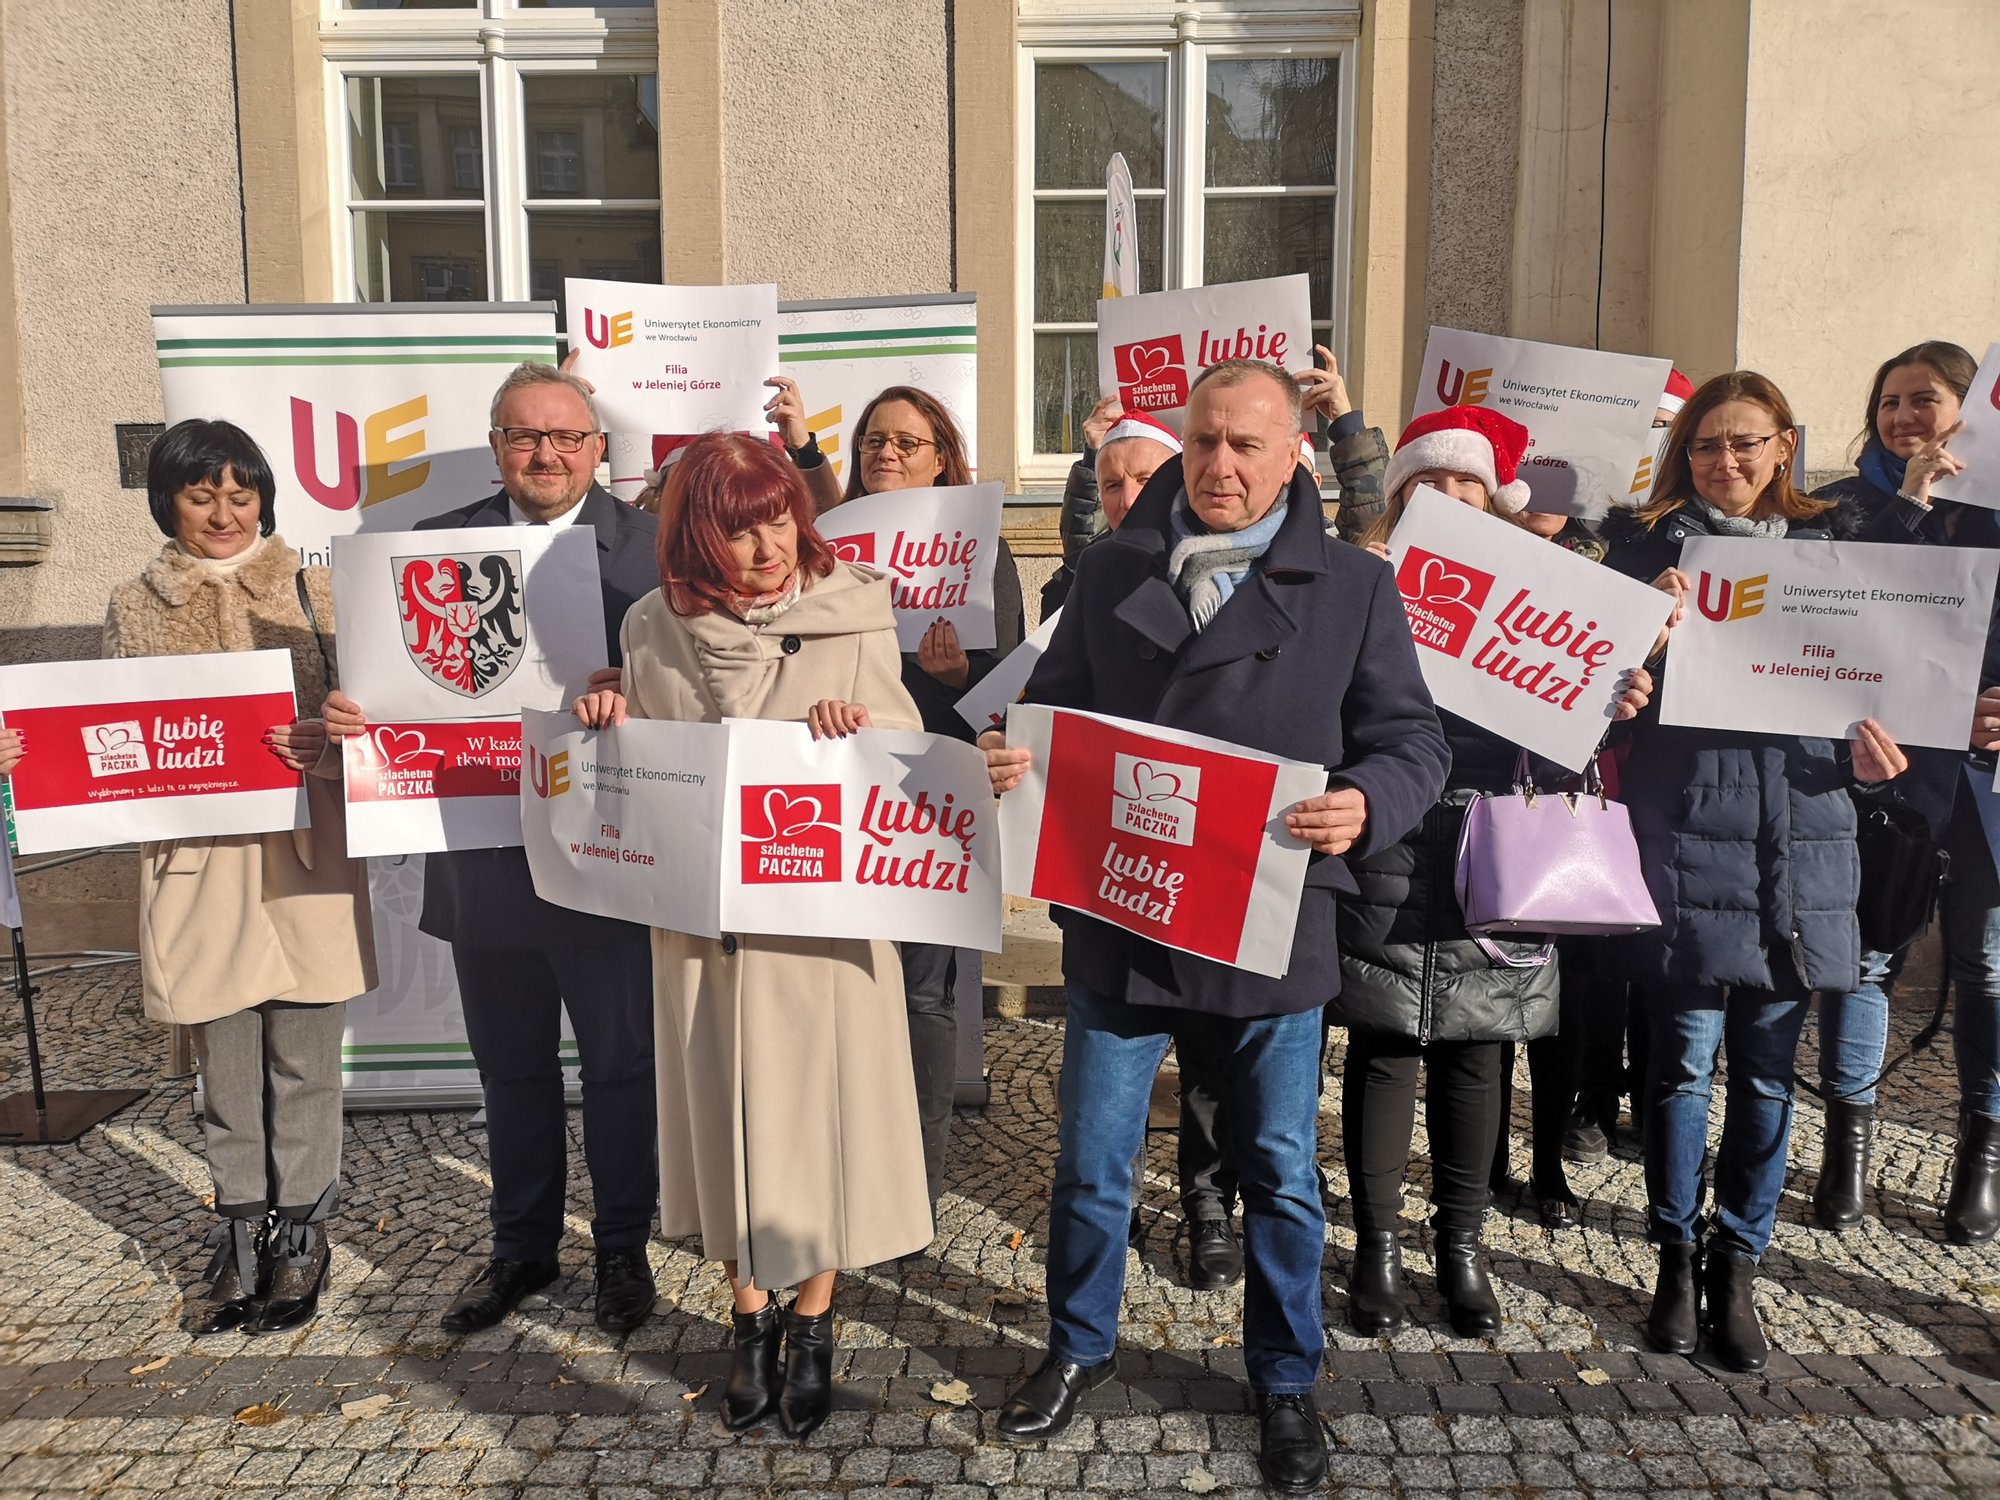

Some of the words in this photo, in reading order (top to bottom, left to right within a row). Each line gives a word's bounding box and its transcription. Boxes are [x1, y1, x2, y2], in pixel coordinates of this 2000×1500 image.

[584, 307, 634, 350] UE
[644, 318, 700, 330] Uniwersytet
[703, 318, 762, 329] Ekonomiczny
[658, 333, 698, 342] Wrocławiu
[1197, 324, 1289, 369] Lubię
[665, 364, 688, 375] Filia
[632, 381, 642, 389] w
[645, 380, 687, 392] Jeleniej
[690, 380, 721, 390] Górze
[1132, 382, 1176, 395] szlachetna
[1436, 358, 1493, 407] UE
[1502, 378, 1568, 399] Uniwersytet
[1569, 389, 1641, 409] Ekonomiczny
[1133, 392, 1179, 408] PACZKA
[1499, 396, 1513, 406] we
[1513, 397, 1559, 413] Wrocławiu
[290, 394, 431, 512] UE
[1532, 454, 1569, 469] Górze
[887, 530, 978, 579] Lubię
[891, 573, 971, 610] ludzi
[1697, 570, 1769, 623] UE
[1783, 584, 1867, 601] Uniwersytet
[1870, 589, 1966, 608] Ekonomiczny
[1403, 601, 1456, 633] szlachetna
[1781, 605, 1798, 614] we
[1800, 604, 1859, 617] Wrocławiu
[1494, 588, 1615, 676] Lubię
[1802, 644, 1836, 659] Filia
[1471, 635, 1590, 712] ludzi
[1751, 663, 1766, 674] w
[1769, 662, 1830, 681] Jeleniej
[1835, 667, 1883, 683] Górze
[152, 713, 225, 749] Lubię
[466, 737, 484, 751] W
[100, 753, 137, 761] szlachetna
[101, 760, 139, 772] PACZKA
[156, 743, 225, 770] ludzi
[456, 752, 491, 767] tkwi
[377, 768, 433, 781] szlachetna
[529, 743, 571, 800] UE
[581, 761, 634, 779] Uniwersytet
[636, 766, 706, 786] Ekonomiczny
[378, 780, 434, 797] PACZKA
[582, 781, 595, 791] we
[596, 781, 630, 796] Wrocławiu
[858, 784, 978, 852] Lubię
[1127, 802, 1180, 825] szlachetna
[600, 823, 621, 840] Filia
[1125, 811, 1178, 840] PACZKA
[570, 842, 580, 855] w
[581, 840, 620, 863] Jeleniej
[622, 850, 655, 867] Górze
[760, 842, 824, 859] szlachetna
[758, 857, 824, 878] PACZKA
[855, 844, 970, 894] ludzi
[1101, 841, 1185, 899] Lubię
[1098, 872, 1178, 926] ludzi
